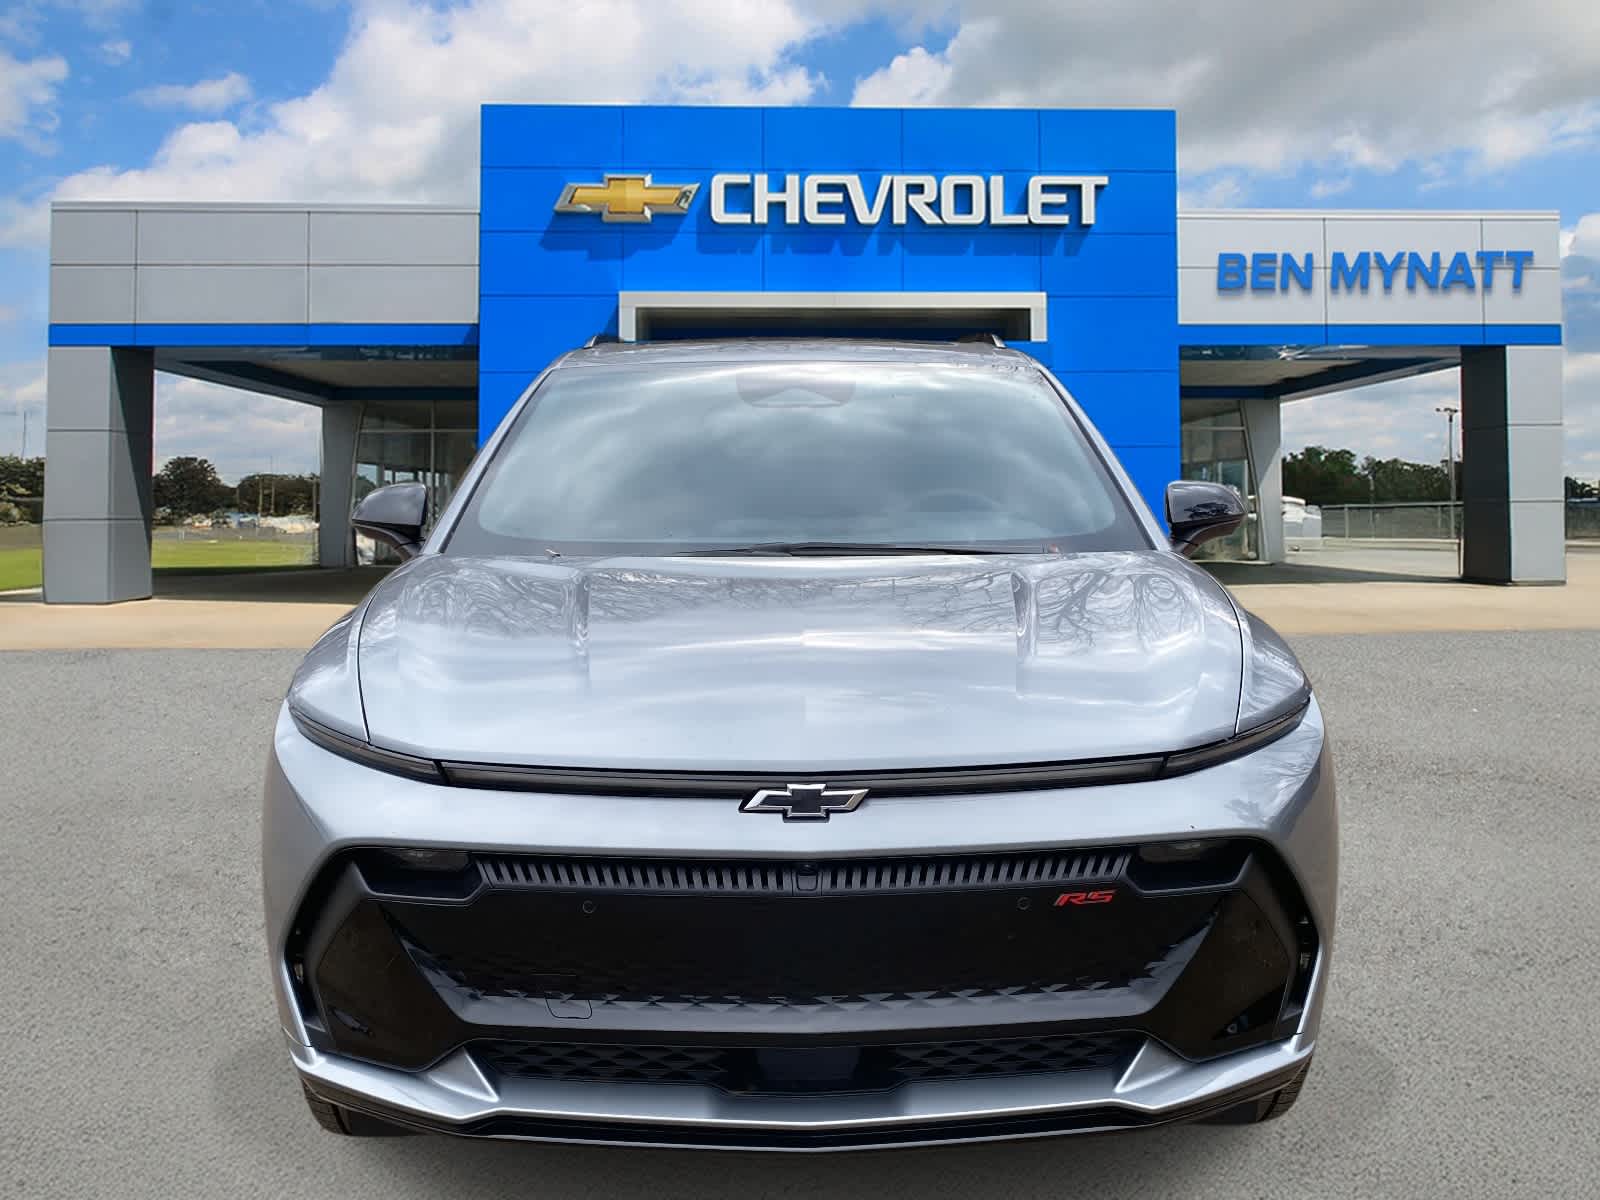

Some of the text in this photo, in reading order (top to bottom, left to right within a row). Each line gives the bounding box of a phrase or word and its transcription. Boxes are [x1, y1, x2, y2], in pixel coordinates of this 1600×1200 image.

[710, 173, 1109, 225] CHEVROLET
[1217, 250, 1534, 291] BEN MYNATT
[1053, 889, 1117, 906] RS
